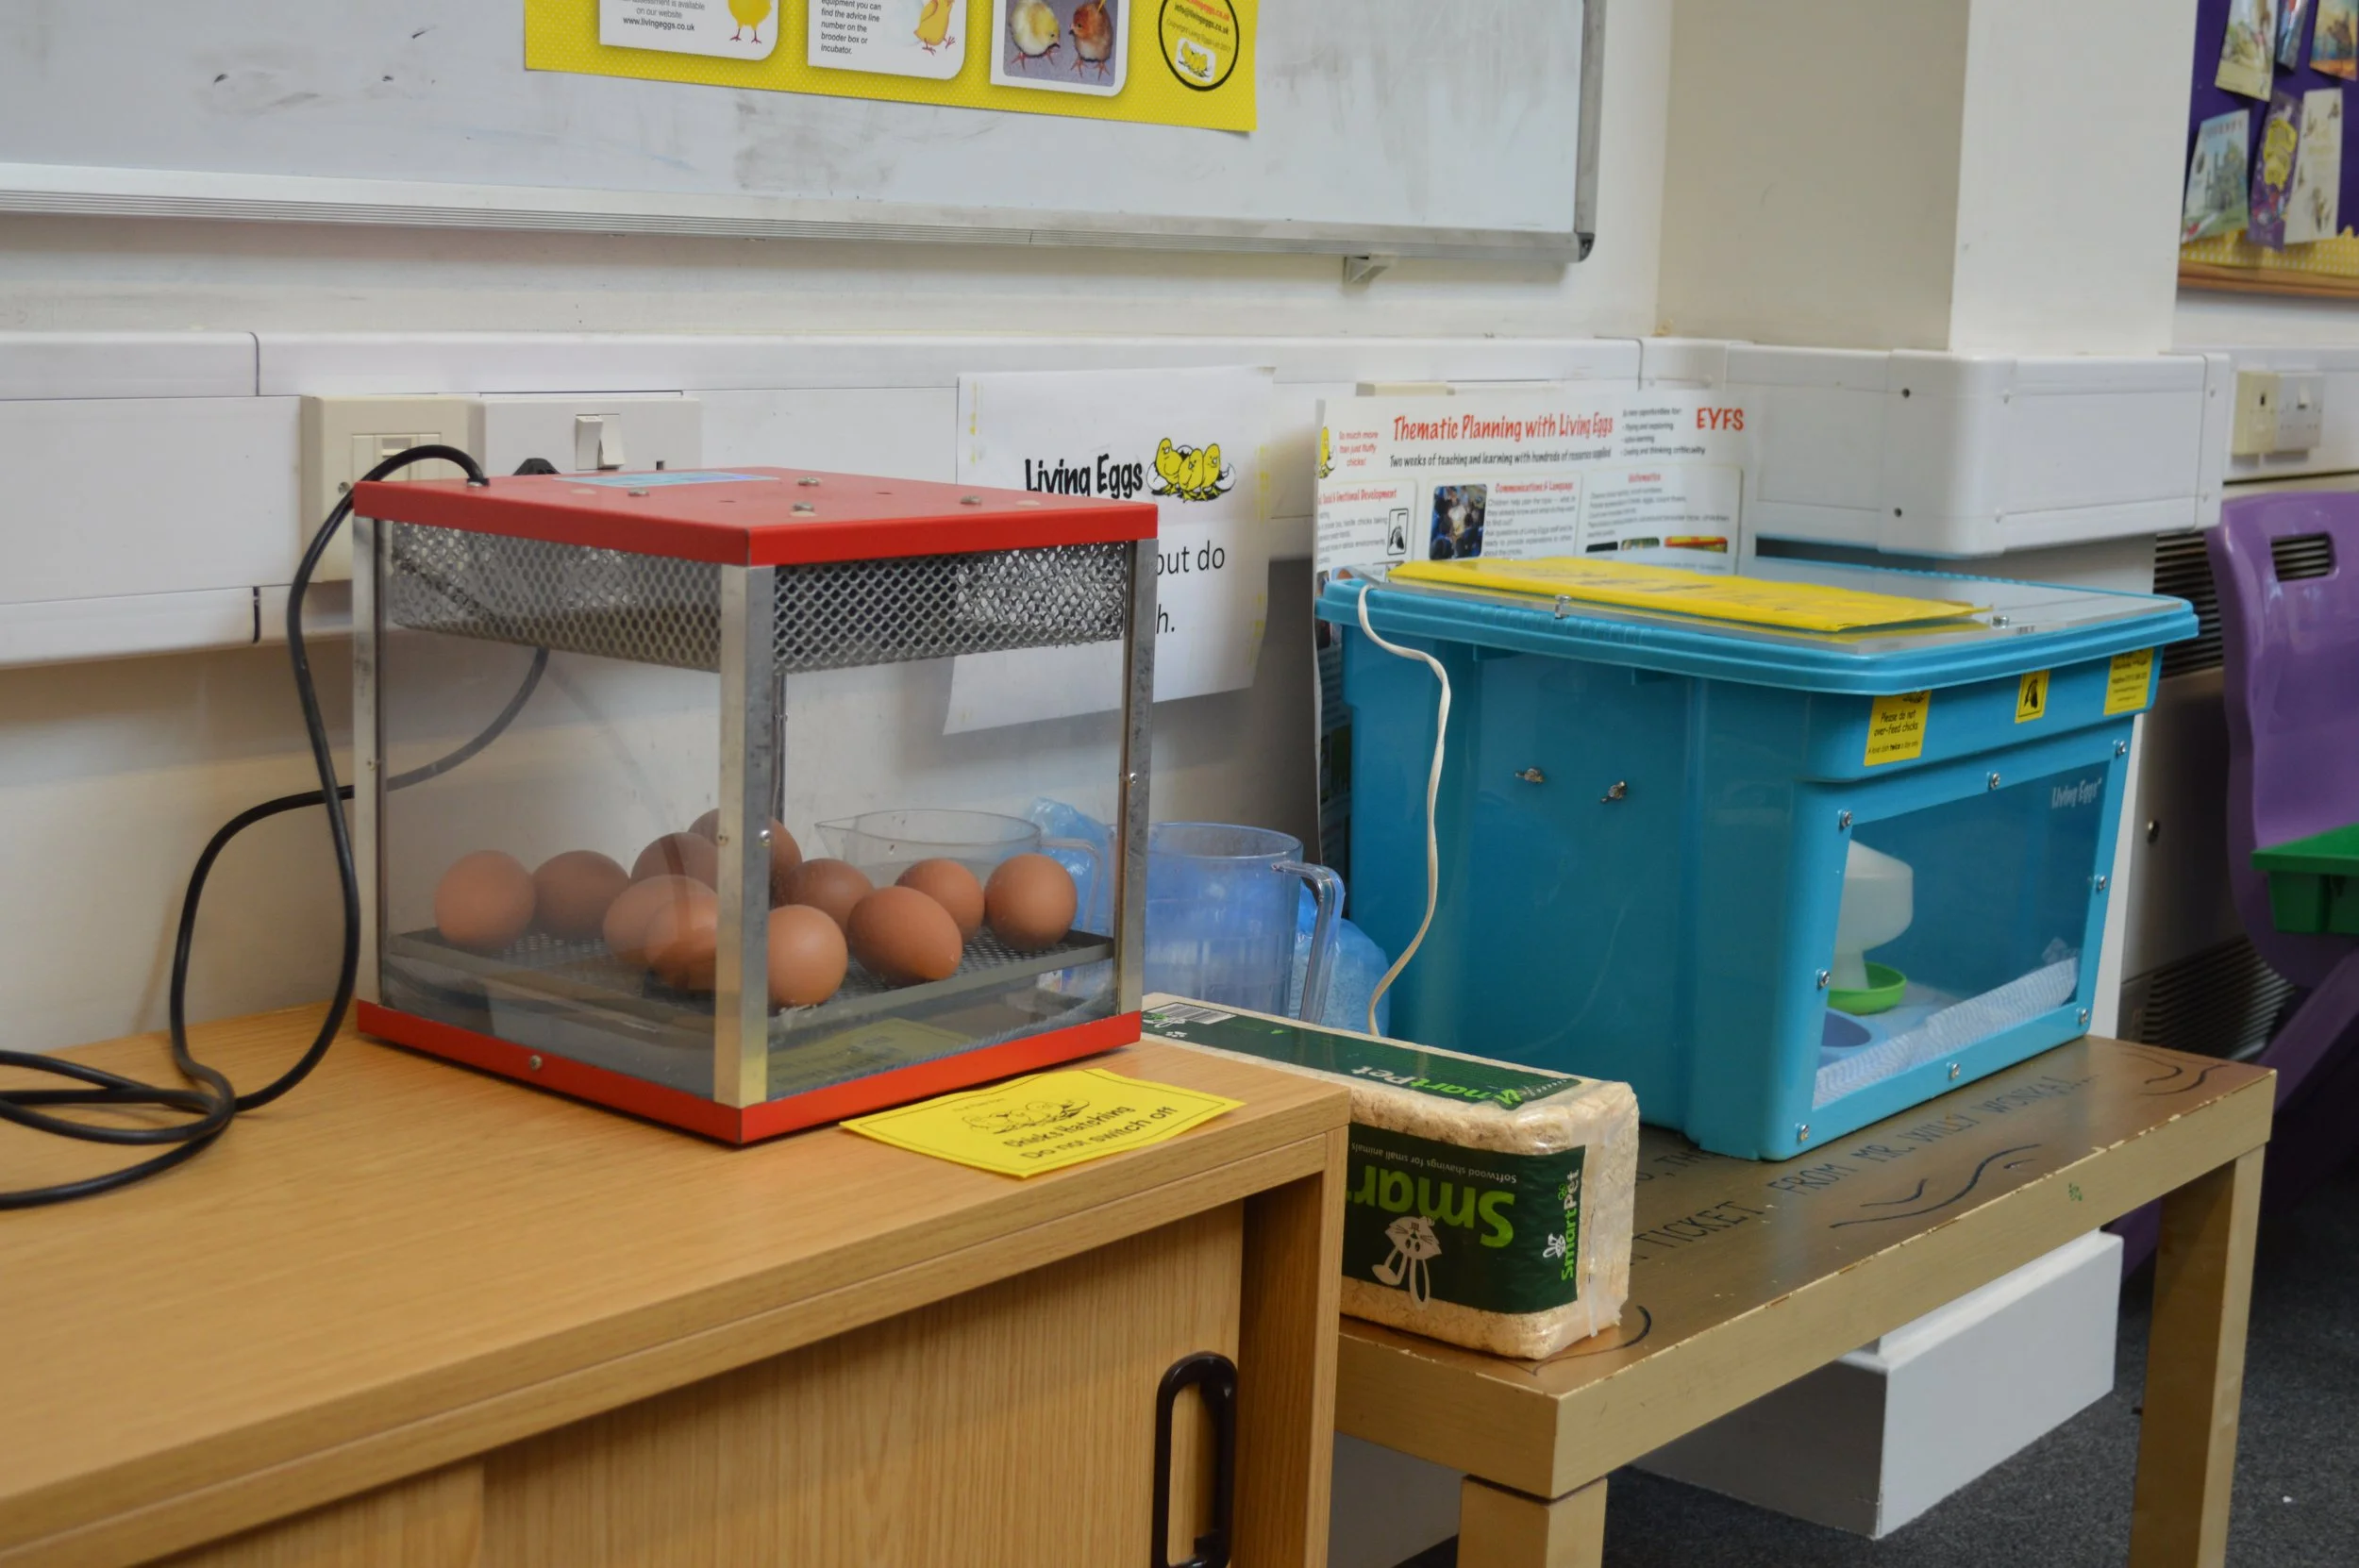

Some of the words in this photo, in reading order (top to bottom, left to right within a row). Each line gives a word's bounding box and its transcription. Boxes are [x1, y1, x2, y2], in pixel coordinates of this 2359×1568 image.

[678, 1, 705, 10] available
[869, 3, 881, 11] can
[659, 9, 683, 19] website
[821, 8, 834, 17] find
[834, 9, 845, 18] the
[845, 11, 866, 21] advice
[868, 13, 879, 23] line
[623, 16, 695, 31] www.livingeggs.co.uk
[821, 21, 846, 30] number
[847, 24, 856, 32] on
[857, 24, 867, 33] the
[821, 32, 846, 42] brooder
[847, 34, 860, 43] box
[821, 44, 853, 55] incubator.
[1393, 415, 1459, 442] Thematic
[1462, 414, 1522, 442] Planning
[1525, 413, 1556, 438] with
[1559, 412, 1591, 440] Living
[1593, 411, 1614, 439] Eggs
[1696, 407, 1745, 431] EYFS
[1347, 430, 1361, 440] much
[1363, 431, 1379, 440] more
[1350, 443, 1361, 455] just
[1362, 443, 1378, 455] fluffy
[1649, 446, 1672, 456] thinking
[1390, 454, 1402, 468] Two
[1404, 454, 1427, 467] weeks
[1428, 453, 1437, 467] of
[1437, 453, 1468, 468] teaching
[1469, 453, 1481, 465] and
[1481, 451, 1513, 467] learning
[1514, 450, 1531, 464] with
[1532, 449, 1561, 463] hundreds
[1561, 449, 1568, 461] of
[1025, 458, 1091, 496] Living
[1096, 454, 1144, 499] Eggs
[1361, 489, 1397, 502] Development
[1197, 540, 1225, 571] do
[1881, 710, 1898, 724] Please
[1899, 709, 1906, 721] do
[1907, 709, 1916, 719] not
[1874, 723, 1901, 737] over-feed
[1902, 722, 1918, 732] chicks
[2051, 785, 2078, 809] Living
[2079, 778, 2098, 805] Eggs
[1002, 1130, 1064, 1148] Chicks
[1019, 1149, 1057, 1159] Do
[1056, 1140, 1092, 1151] not
[1089, 1118, 1153, 1143] switch
[1149, 1105, 1179, 1121] off
[1351, 1142, 1384, 1157] animals
[1385, 1149, 1410, 1164] small
[1411, 1157, 1425, 1168] for
[1426, 1158, 1466, 1177] shavings
[1468, 1168, 1517, 1184] Softwood
[1632, 1200, 1765, 1248] TICKET
[1767, 1163, 1859, 1196] FROM
[1851, 1144, 1917, 1162] MR.
[1897, 1113, 1981, 1143] WILLY
[1347, 1165, 1515, 1249] Smar
[1561, 1170, 1580, 1281] SmartPet
